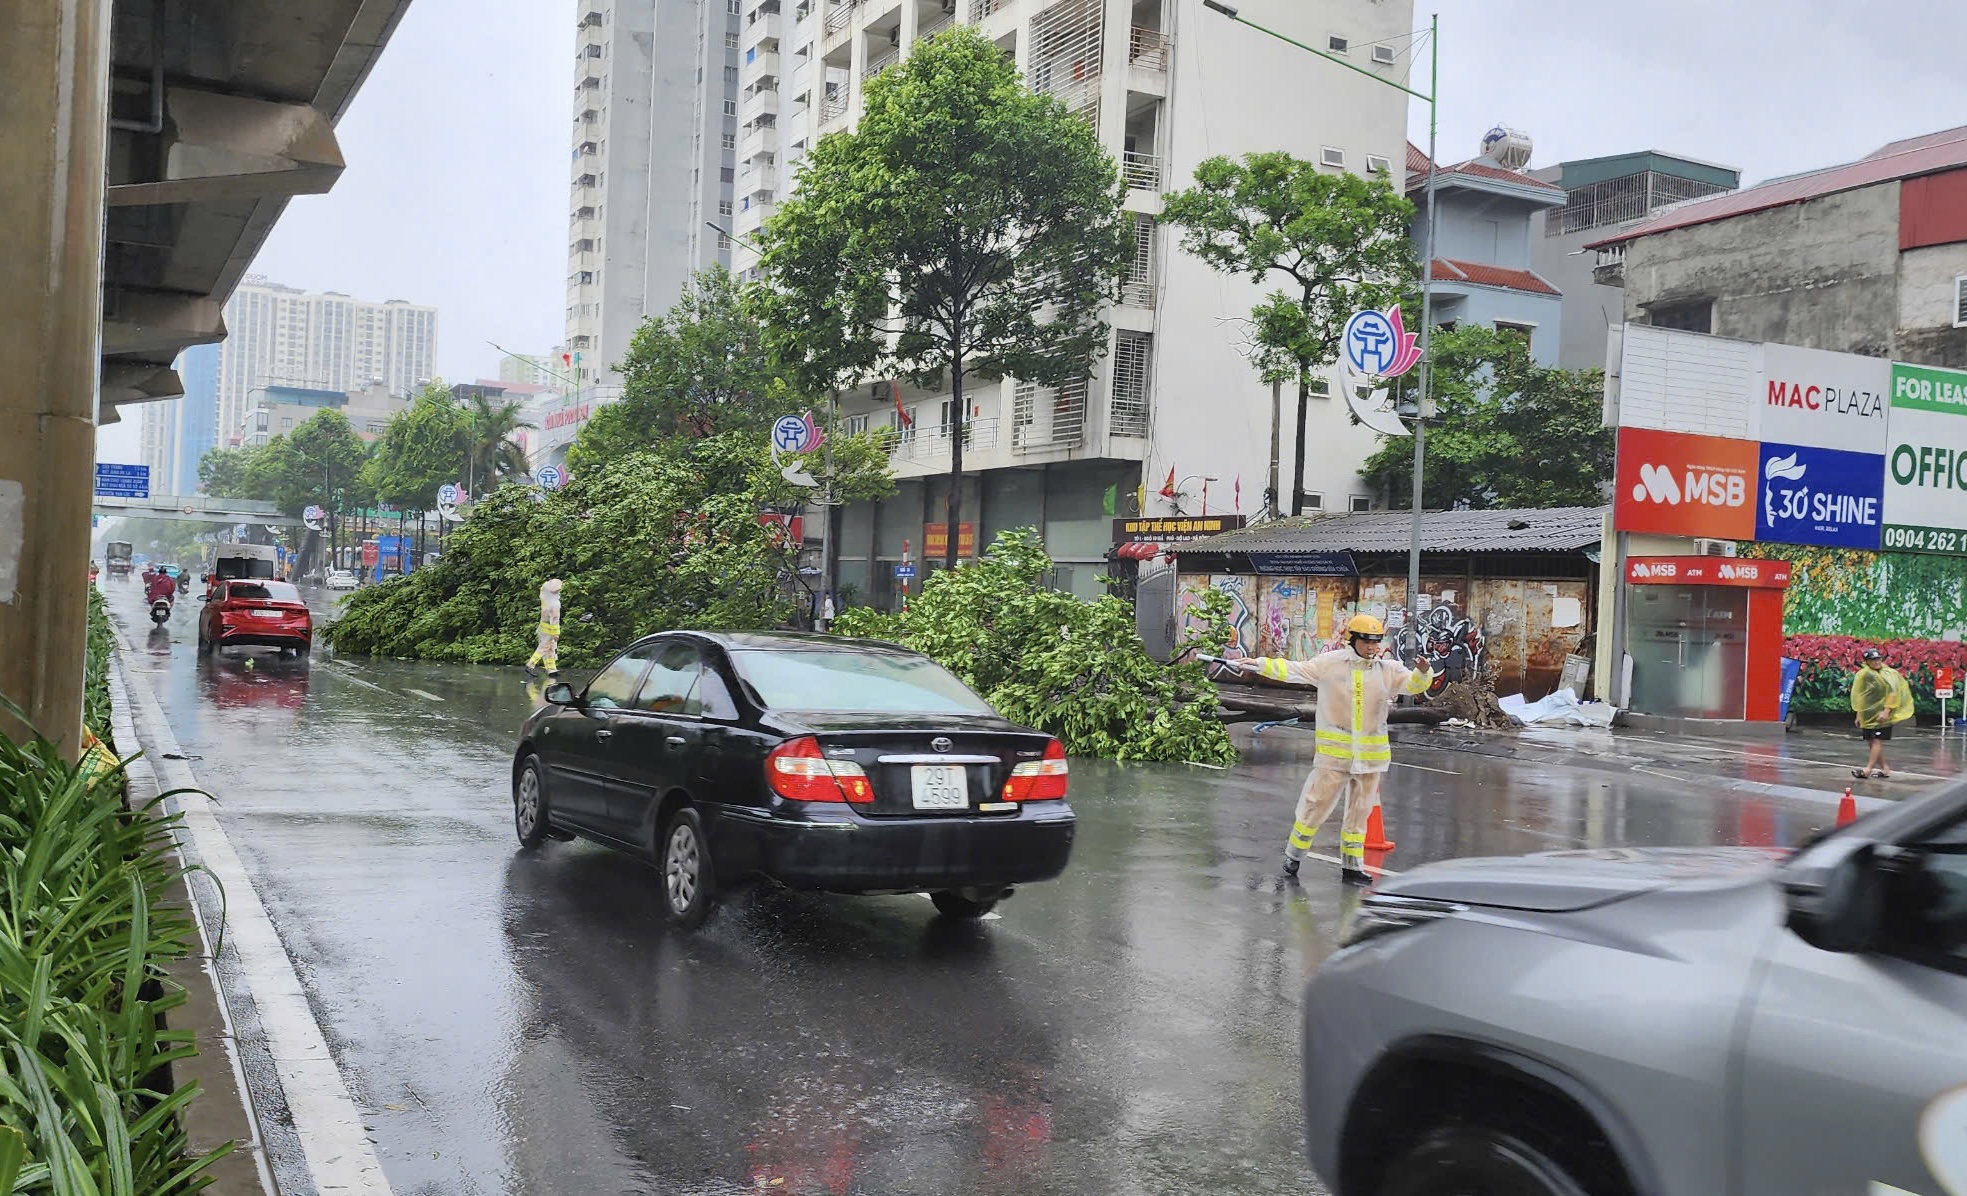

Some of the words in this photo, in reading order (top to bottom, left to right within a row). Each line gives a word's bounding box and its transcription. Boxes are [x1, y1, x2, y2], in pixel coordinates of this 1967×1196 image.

[1767, 380, 1821, 410] MAC
[1825, 387, 1882, 418] PLAZA
[1896, 377, 1931, 401] FOR
[1685, 471, 1745, 507] MSB
[1811, 492, 1877, 525] SHINE
[1163, 520, 1176, 533] HỌC
[1885, 527, 1925, 549] 0904
[1926, 531, 1957, 551] 262
[1651, 564, 1677, 577] MSB
[1735, 566, 1758, 580] MSB
[1936, 669, 1944, 680] P
